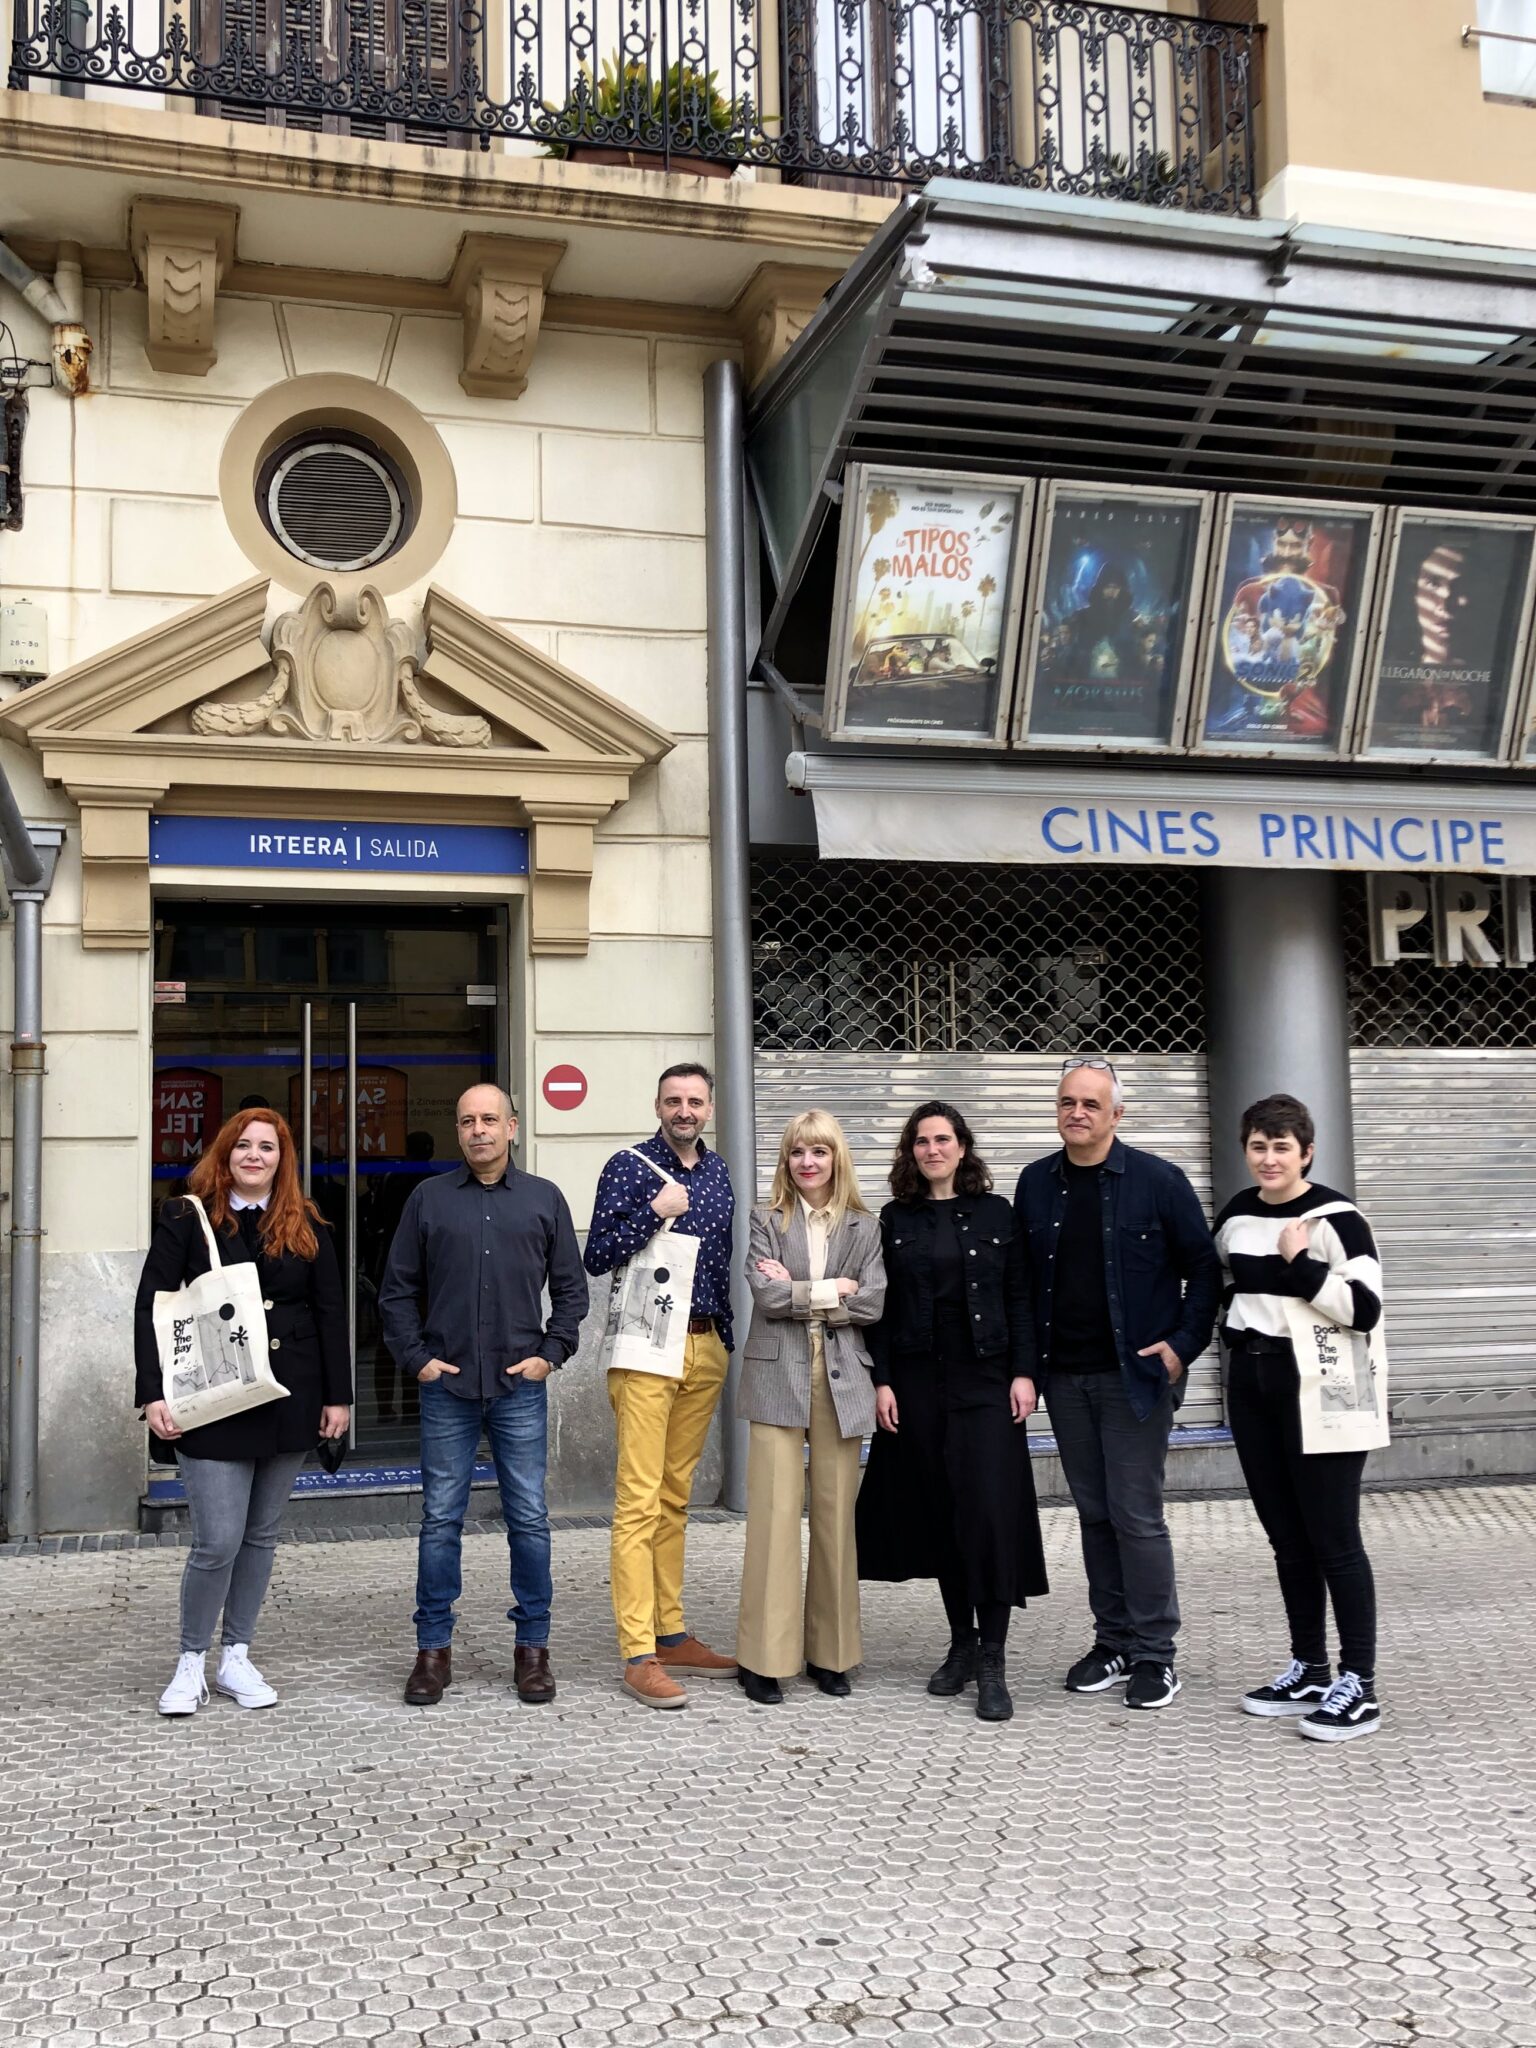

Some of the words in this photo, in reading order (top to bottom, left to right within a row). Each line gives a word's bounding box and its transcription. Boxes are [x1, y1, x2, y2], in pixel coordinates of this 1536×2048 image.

[903, 527, 971, 556] TIPOS
[892, 553, 973, 582] MALOS
[1450, 670, 1492, 682] NOCHE
[1041, 806, 1221, 857] CINES
[1260, 812, 1506, 866] PRINCIPE
[250, 834, 348, 856] IRTEERA
[370, 838, 439, 859] SALIDA
[1366, 872, 1536, 969] PRI
[1313, 1324, 1342, 1334] Dock
[174, 1335, 192, 1346] The
[1314, 1334, 1328, 1344] Of
[174, 1343, 192, 1356] Bay
[1317, 1344, 1337, 1354] The
[1318, 1354, 1340, 1365] Bay
[346, 1476, 412, 1484] SALIDA
